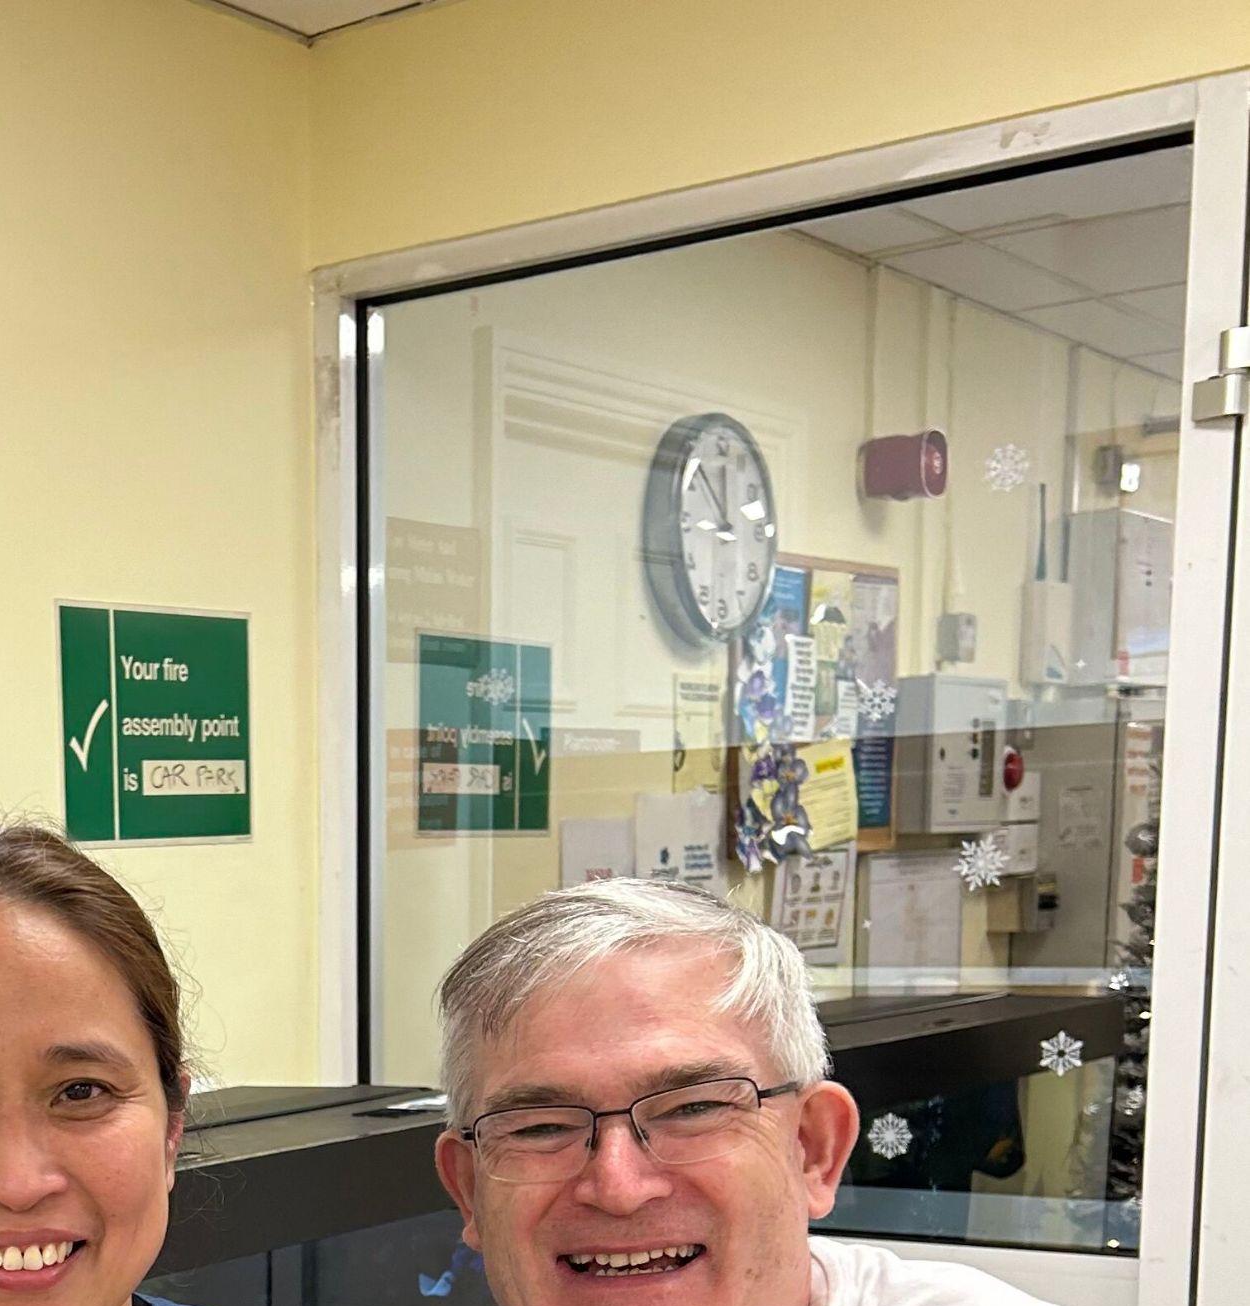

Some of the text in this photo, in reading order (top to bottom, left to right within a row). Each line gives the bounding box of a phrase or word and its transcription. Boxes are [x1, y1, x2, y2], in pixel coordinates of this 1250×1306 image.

[121, 655, 189, 682] Your fire
[122, 713, 240, 742] assembly point
[123, 767, 139, 792] is
[150, 764, 240, 793] CAR PARK
